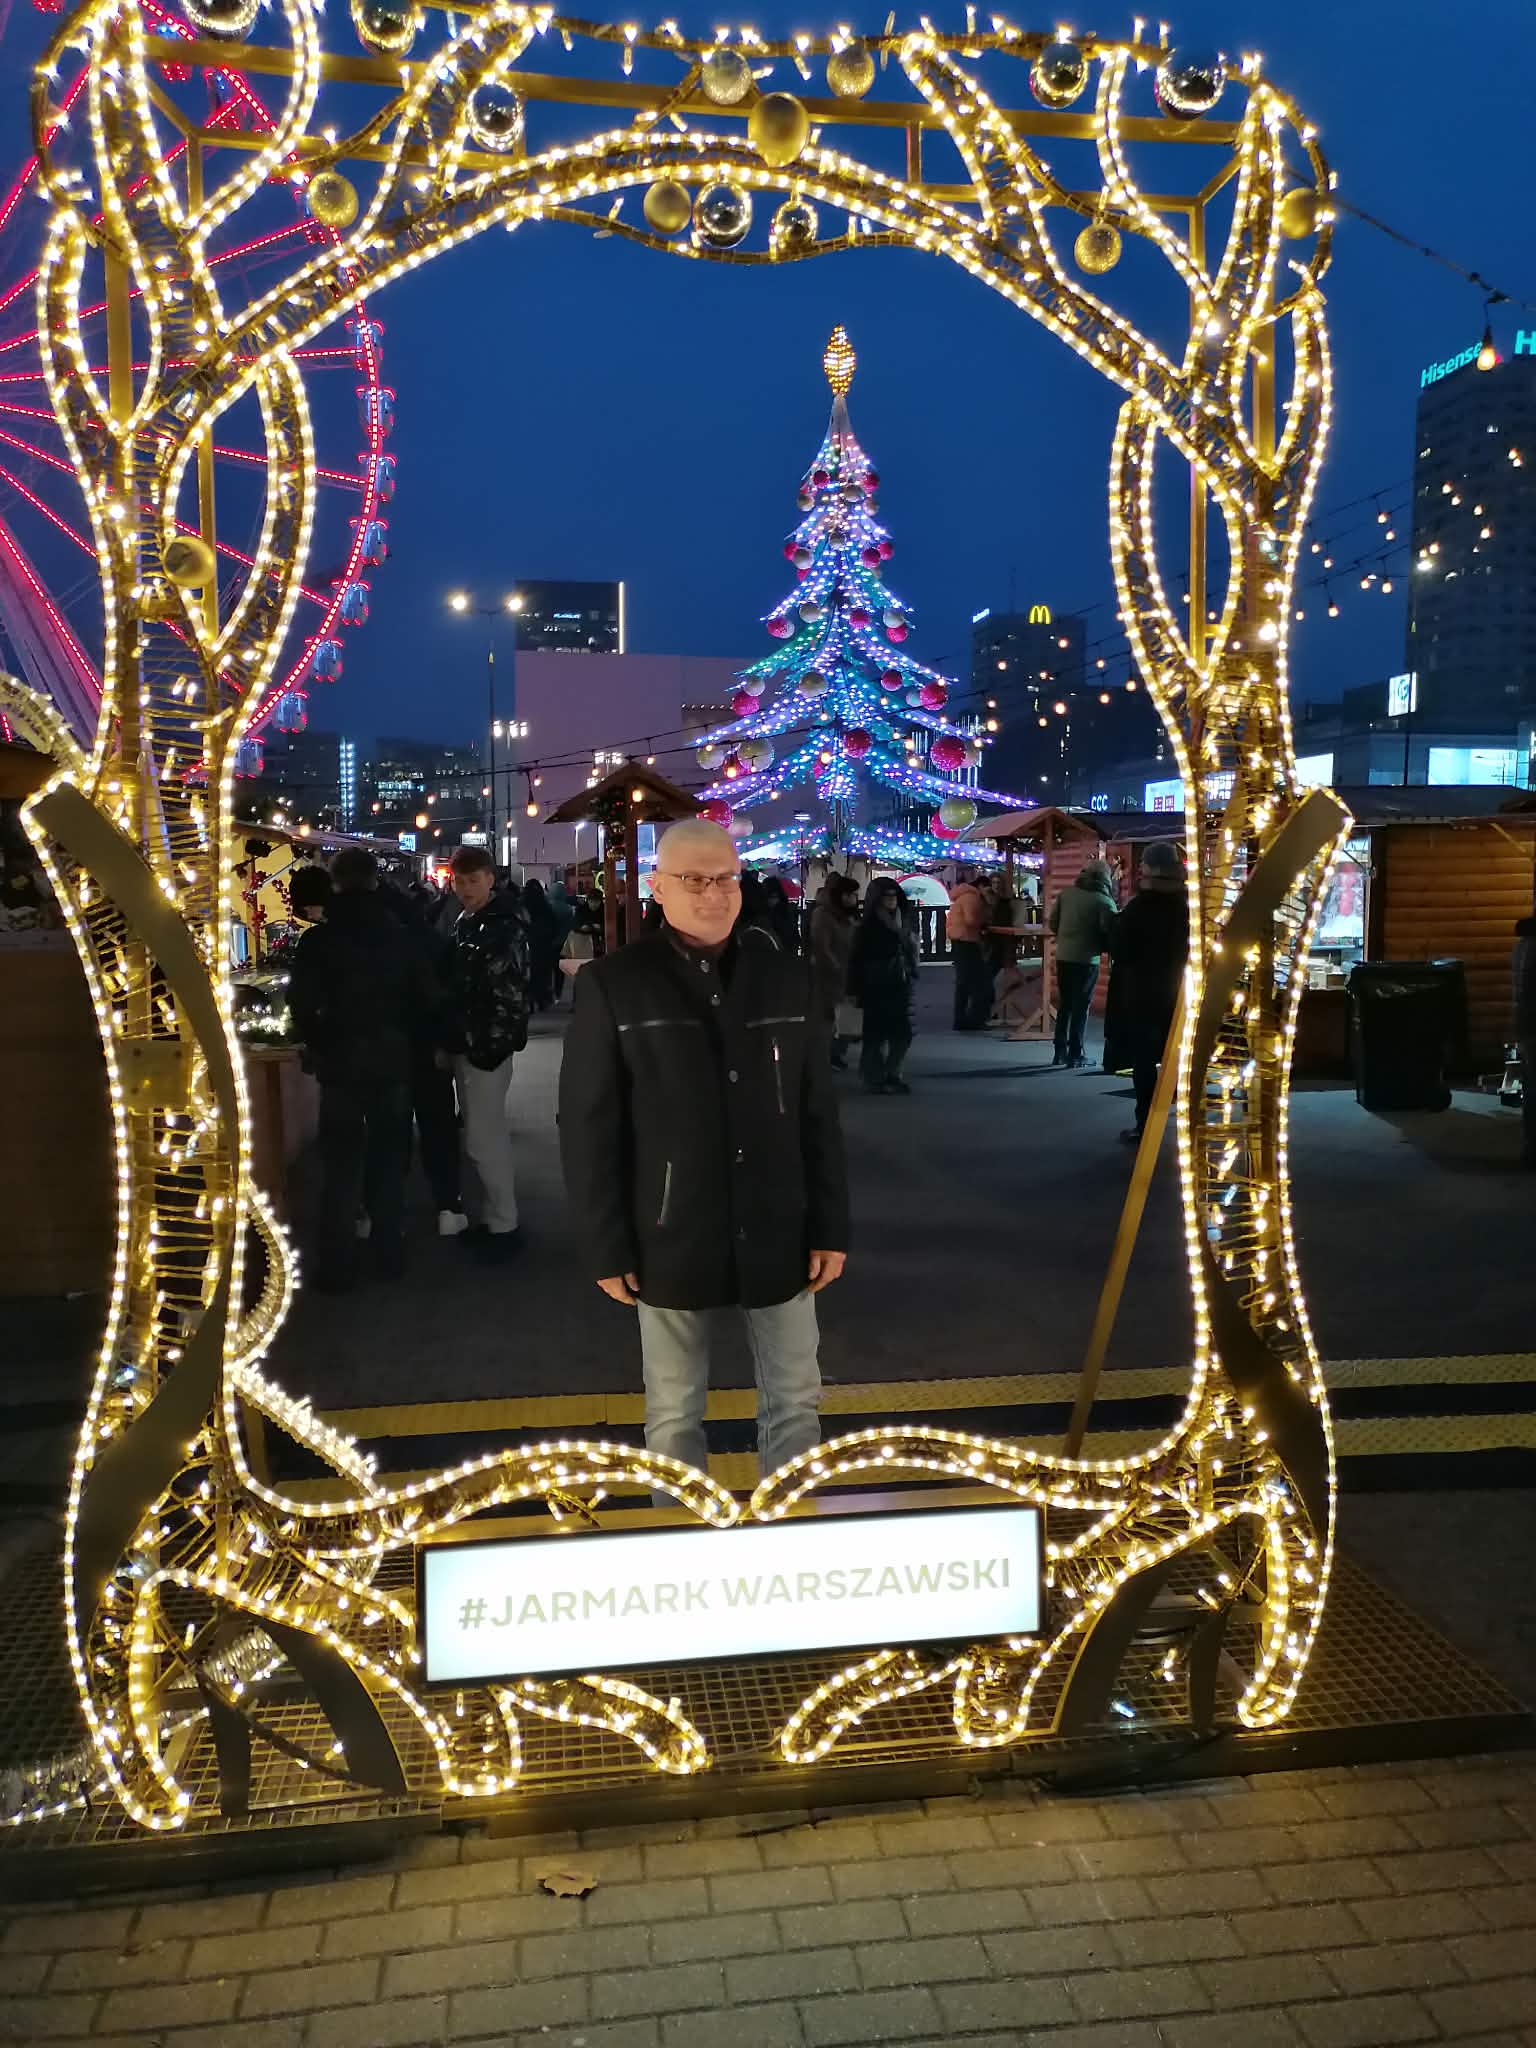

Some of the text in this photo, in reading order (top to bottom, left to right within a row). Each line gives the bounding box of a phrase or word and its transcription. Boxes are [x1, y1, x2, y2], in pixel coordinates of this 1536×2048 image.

[1420, 341, 1483, 388] Hisense
[1091, 794, 1108, 811] CCC
[458, 1557, 1012, 1630] #JARMARK WARSZAWSKI
